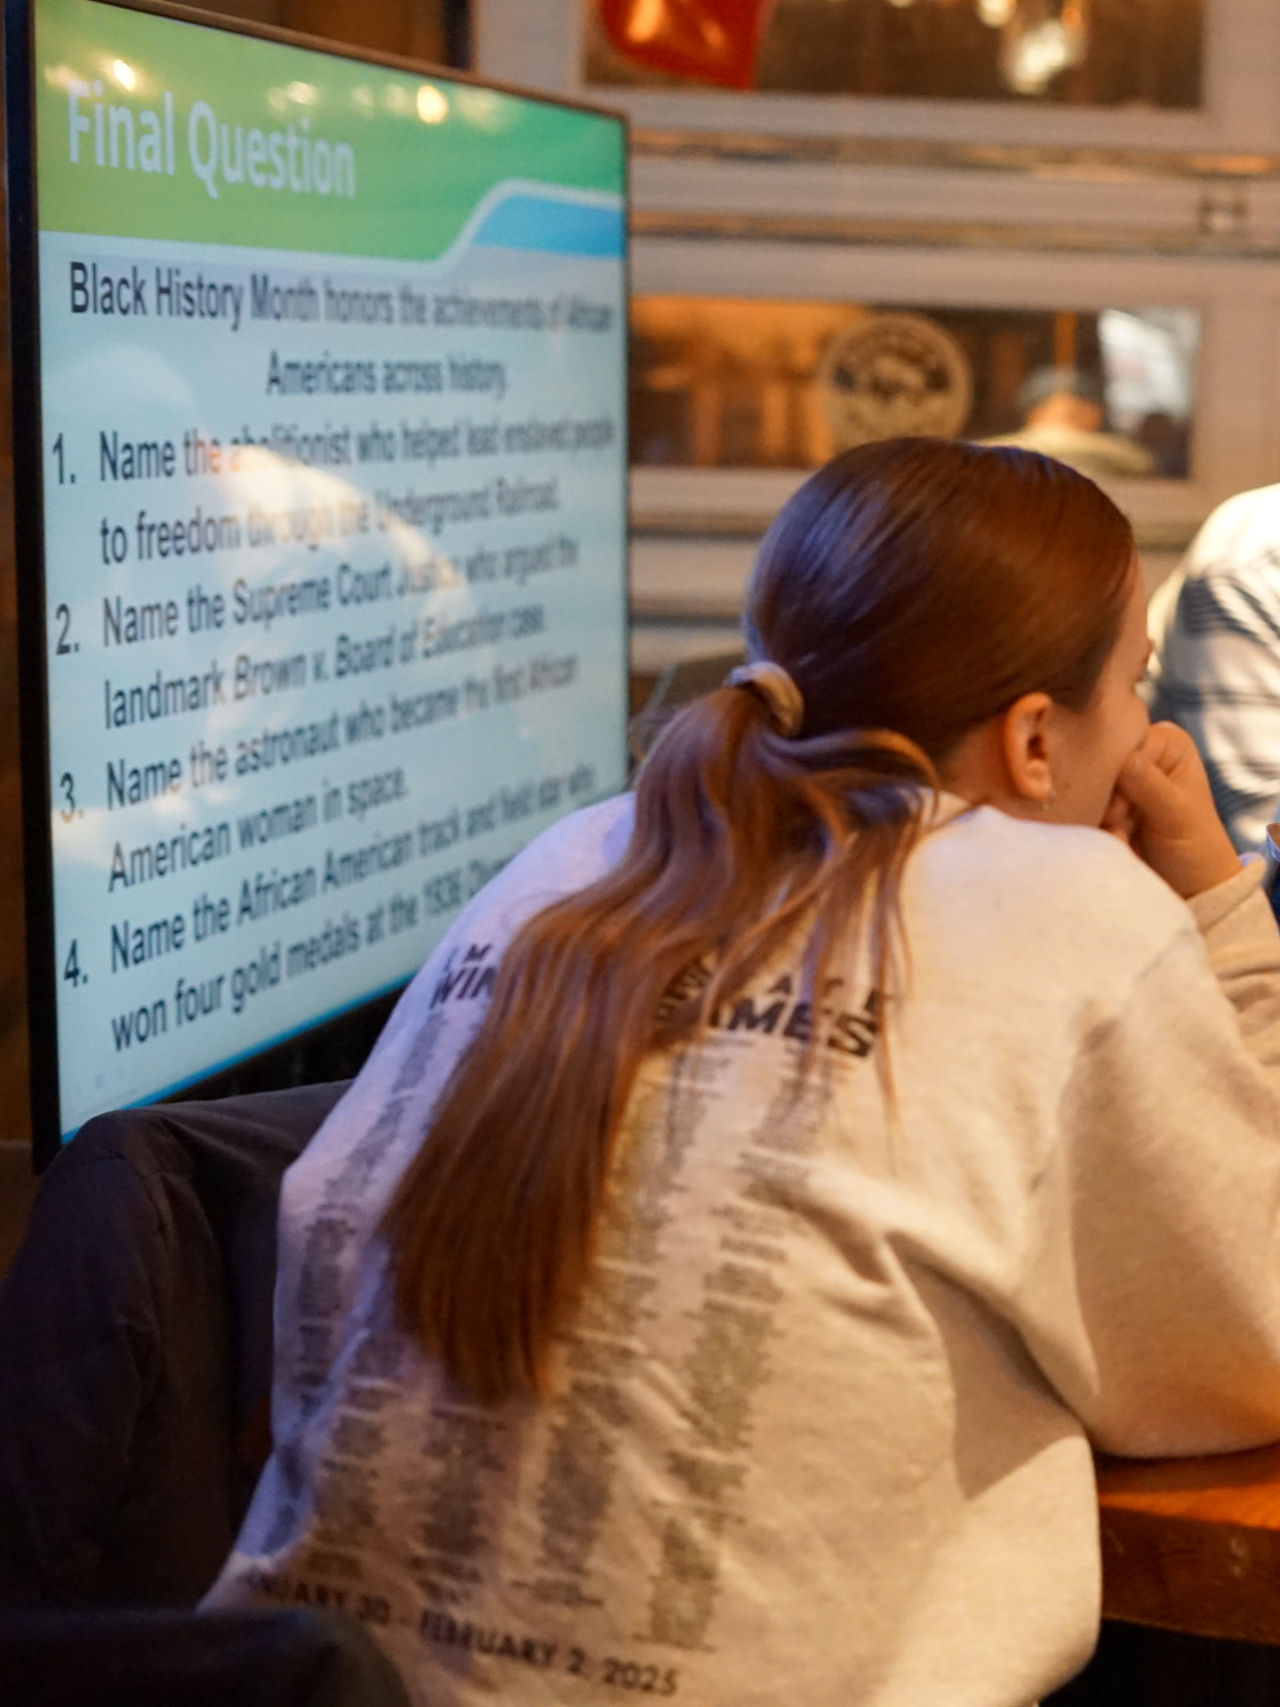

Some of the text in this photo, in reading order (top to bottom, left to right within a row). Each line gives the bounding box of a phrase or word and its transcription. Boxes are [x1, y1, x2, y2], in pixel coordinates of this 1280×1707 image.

[67, 79, 356, 199] Final Question
[69, 261, 148, 316] Black
[155, 266, 244, 332] History
[250, 271, 320, 322] Month
[266, 350, 376, 396] Americans
[383, 361, 443, 394] across
[52, 432, 76, 485] 1.
[100, 430, 176, 482] Name
[183, 428, 222, 476] the
[357, 421, 395, 462] who
[100, 516, 128, 565] to
[135, 506, 241, 561] freedom
[55, 603, 80, 656] 2.
[103, 595, 179, 647] Name
[186, 583, 225, 633] the
[232, 578, 331, 631] Supreme
[335, 562, 391, 606] Court
[104, 659, 228, 730] landmark
[234, 653, 307, 701] Brown
[312, 650, 330, 682] v.
[335, 624, 395, 678] Board
[59, 771, 85, 823] 3.
[107, 757, 183, 810] Name
[189, 740, 229, 788] the
[235, 711, 340, 777] astronaut
[345, 699, 386, 745] who
[107, 821, 232, 893] American
[237, 795, 319, 850] woman
[322, 779, 343, 822] in
[64, 938, 88, 988] 4.
[111, 920, 186, 973] Name
[193, 894, 230, 943] the
[238, 867, 318, 928] African
[321, 830, 414, 896] American
[417, 806, 460, 856] track
[111, 997, 168, 1052] won
[174, 971, 225, 1027] four
[231, 939, 282, 1015] gold
[286, 911, 361, 977] medals
[419, 1608, 560, 1672] FEBRUARY
[602, 1655, 681, 1698] 2025
